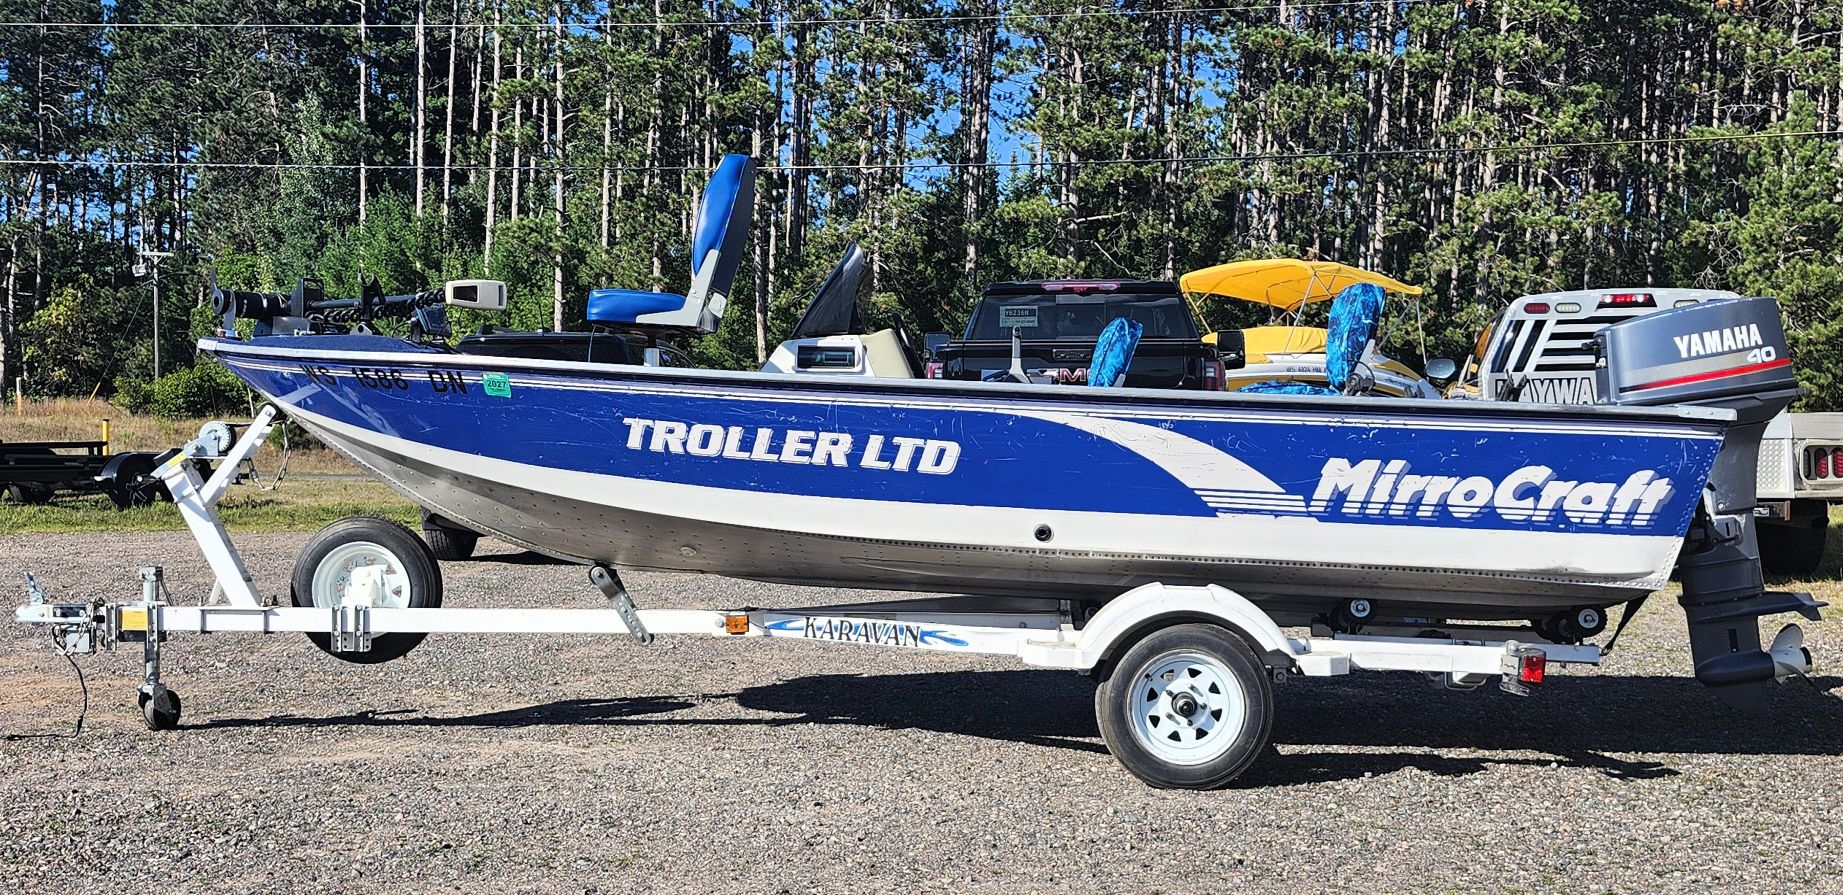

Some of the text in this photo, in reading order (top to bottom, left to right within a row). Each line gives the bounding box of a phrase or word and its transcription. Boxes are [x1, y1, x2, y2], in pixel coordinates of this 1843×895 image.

[1673, 323, 1763, 358] YAMAHA
[1746, 345, 1776, 364] 40
[352, 367, 409, 390] 1586
[427, 370, 468, 395] DN
[486, 380, 507, 389] 2027
[1495, 377, 1597, 405] AYWA
[623, 417, 962, 476] TROLLER LTD
[1306, 457, 1676, 528] MirroCraft
[804, 616, 921, 648] KARAVAN
